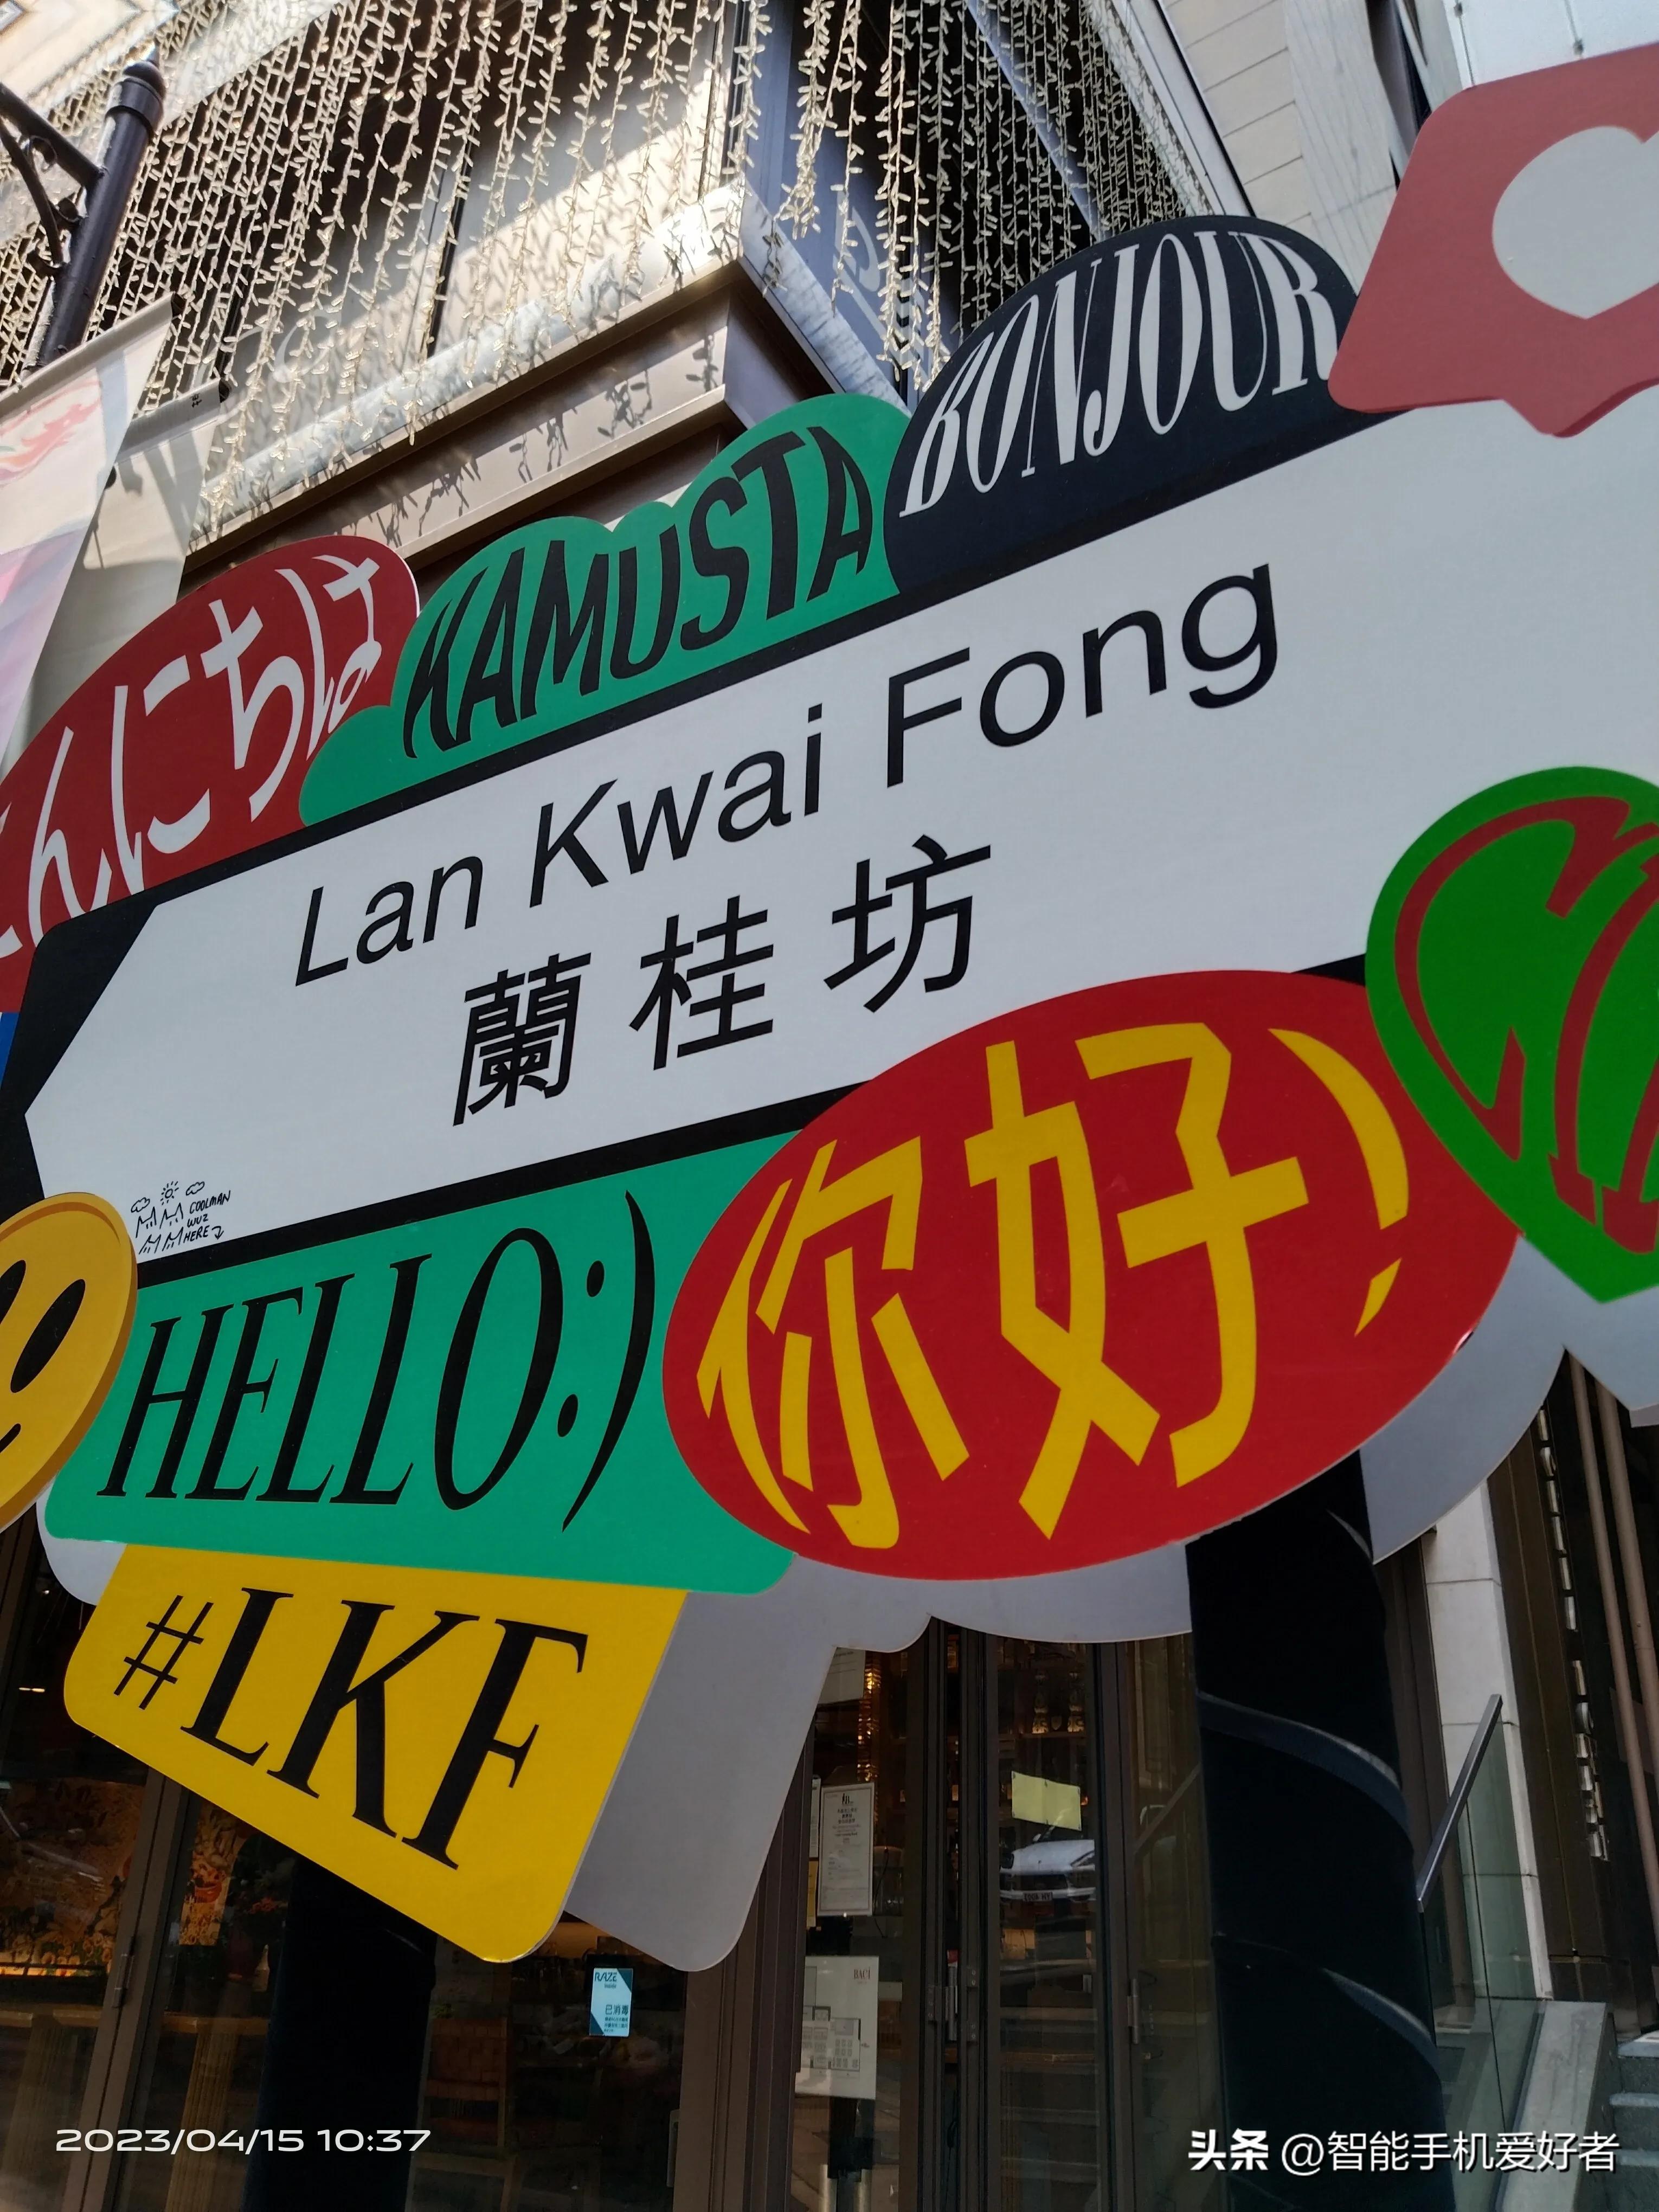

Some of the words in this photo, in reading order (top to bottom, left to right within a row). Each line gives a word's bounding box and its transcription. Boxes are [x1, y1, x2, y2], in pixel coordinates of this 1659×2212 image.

[899, 230, 1341, 518] BONJOUR
[403, 427, 873, 759] KAMUSTA
[294, 856, 484, 987] Lan
[529, 703, 822, 909] Kwai
[886, 563, 1279, 789] Fong
[453, 834, 992, 1127] 蘭桂坊
[183, 1225, 210, 1244] HERE
[190, 1190, 231, 1214] COOLMAN
[113, 1587, 589, 1870] #LKF
[605, 2004, 629, 2015] 已消毒
